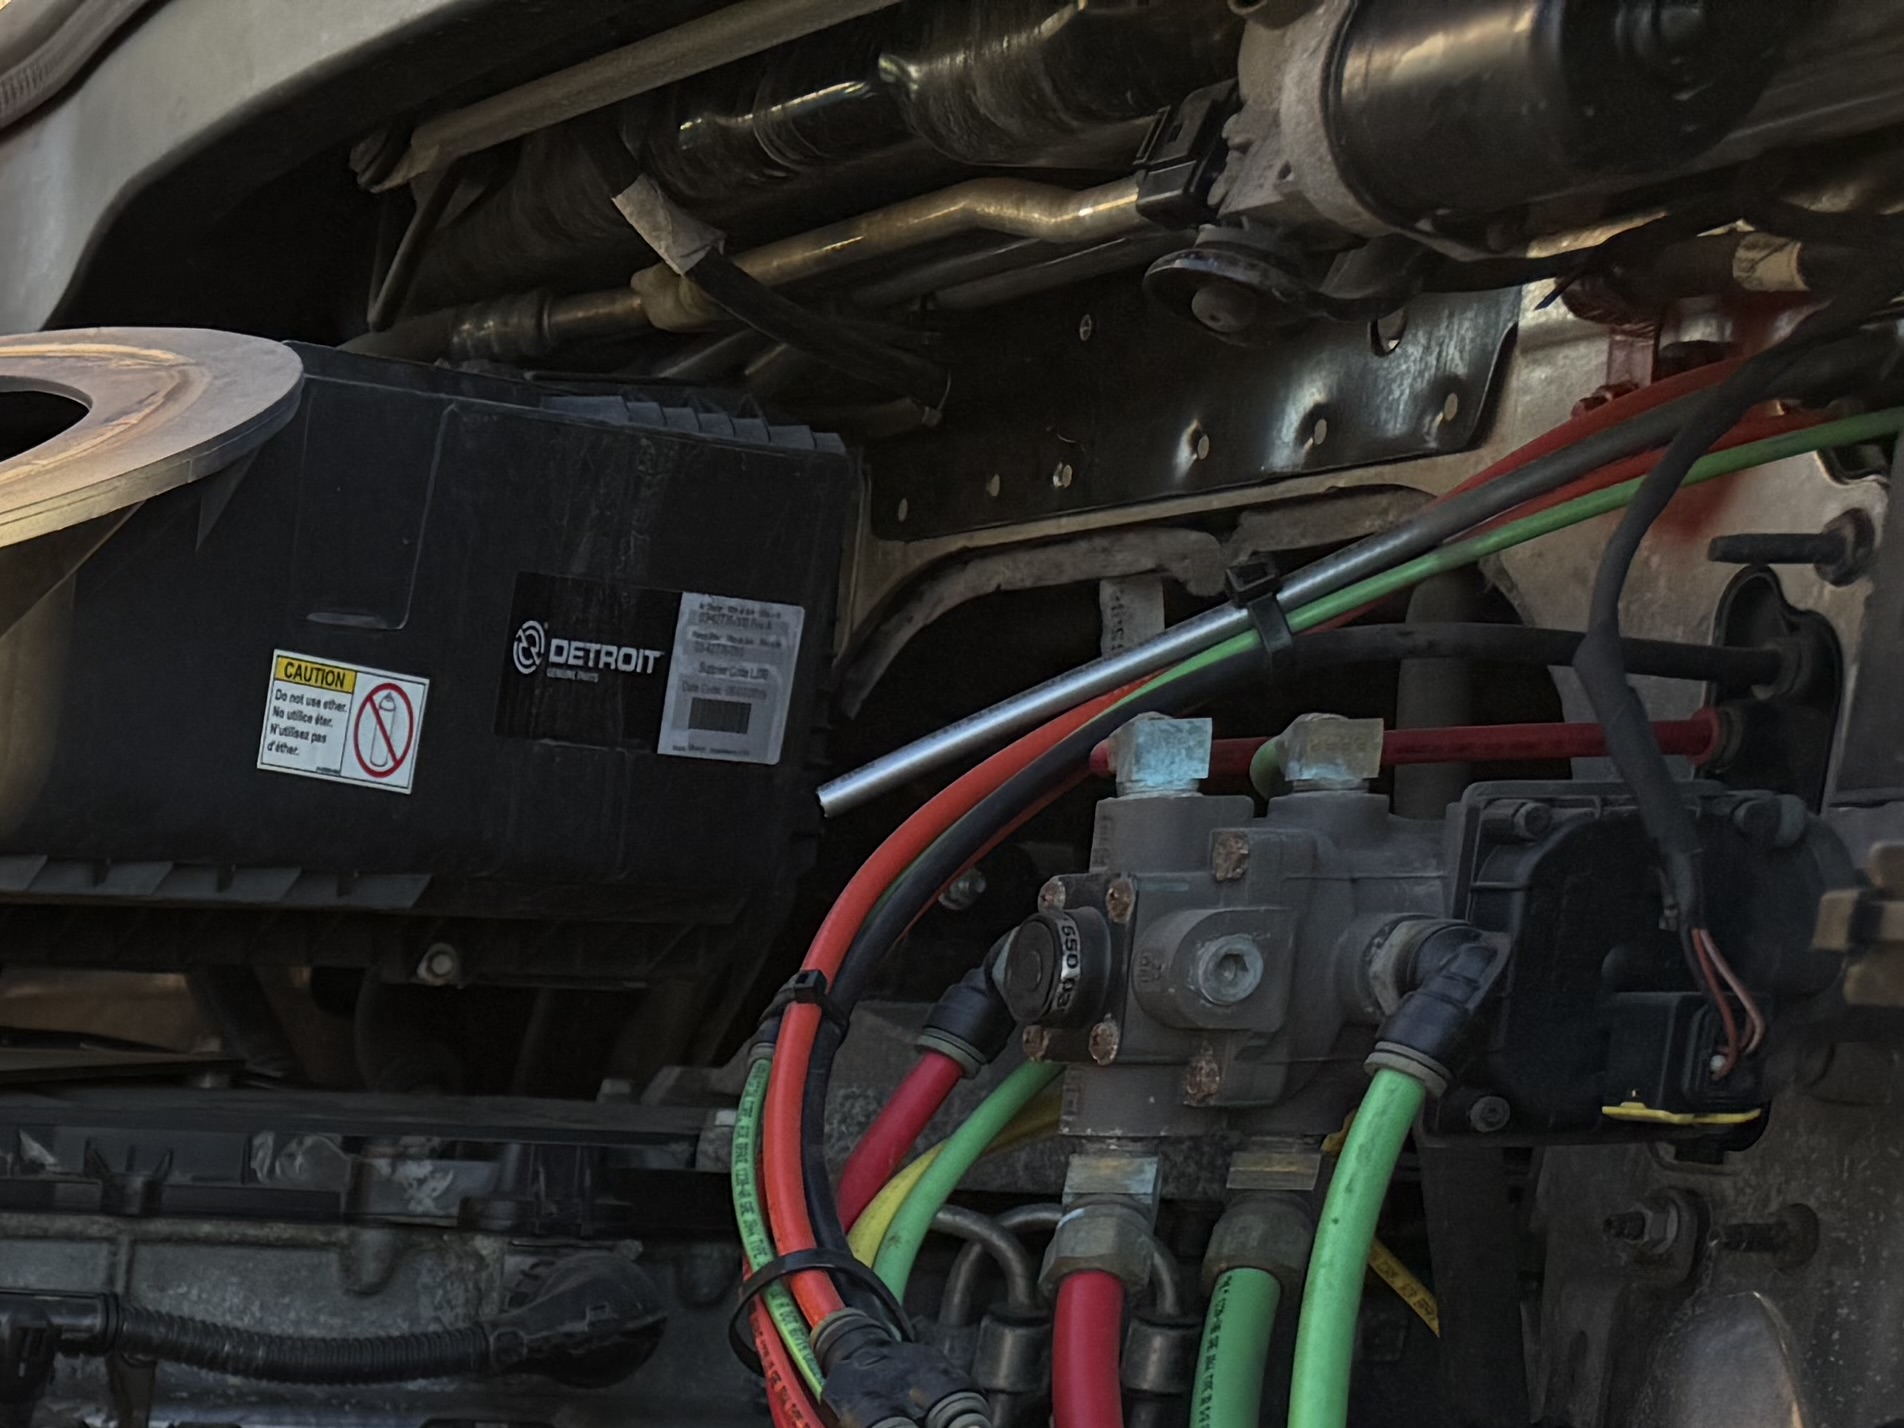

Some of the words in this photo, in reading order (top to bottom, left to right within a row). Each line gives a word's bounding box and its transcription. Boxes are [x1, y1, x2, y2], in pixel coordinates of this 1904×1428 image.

[549, 639, 665, 674] DETROIT
[284, 662, 346, 689] CAUTION
[275, 689, 288, 702] Do
[289, 693, 304, 705] not
[306, 696, 321, 709] use
[273, 705, 284, 719] No
[310, 732, 327, 745] pas
